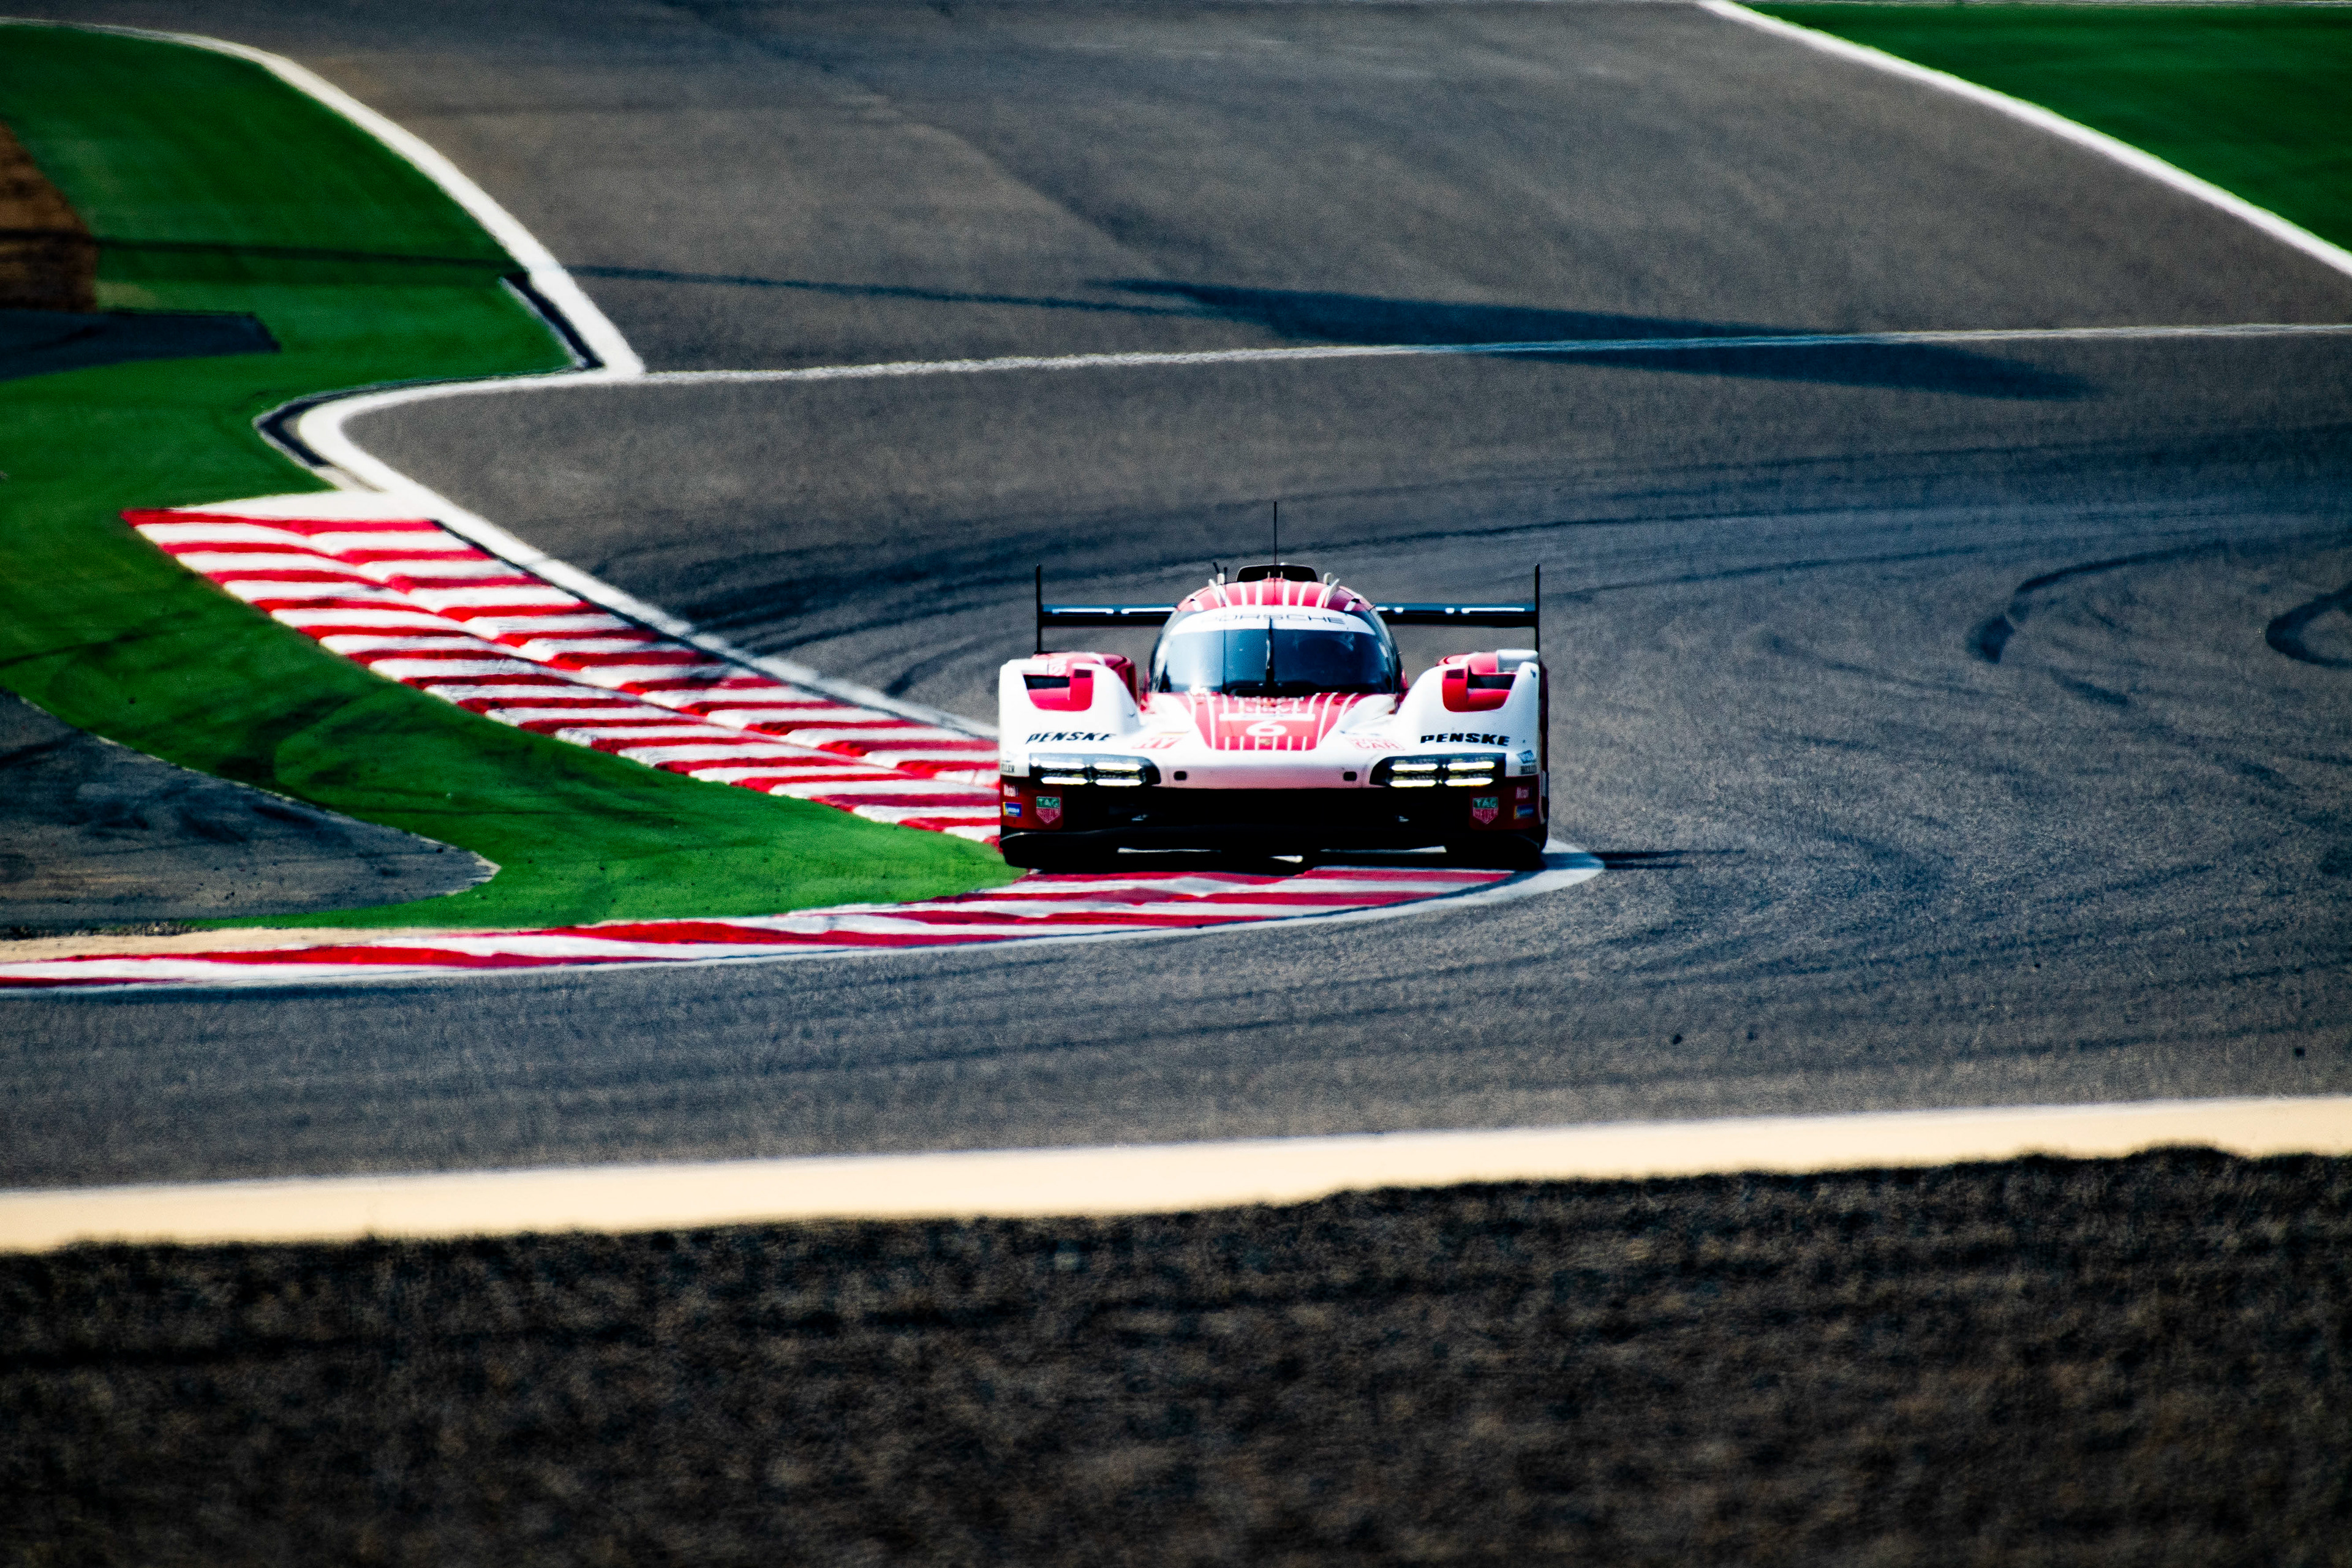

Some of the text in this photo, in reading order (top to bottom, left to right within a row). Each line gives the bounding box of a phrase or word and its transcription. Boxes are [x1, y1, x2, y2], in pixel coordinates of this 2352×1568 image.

[1246, 720, 1287, 737] 6
[1025, 731, 1117, 745] PENSKE
[1420, 733, 1511, 747] PENSKE
[1038, 798, 1060, 807] TAG
[1474, 798, 1497, 807] TAG
